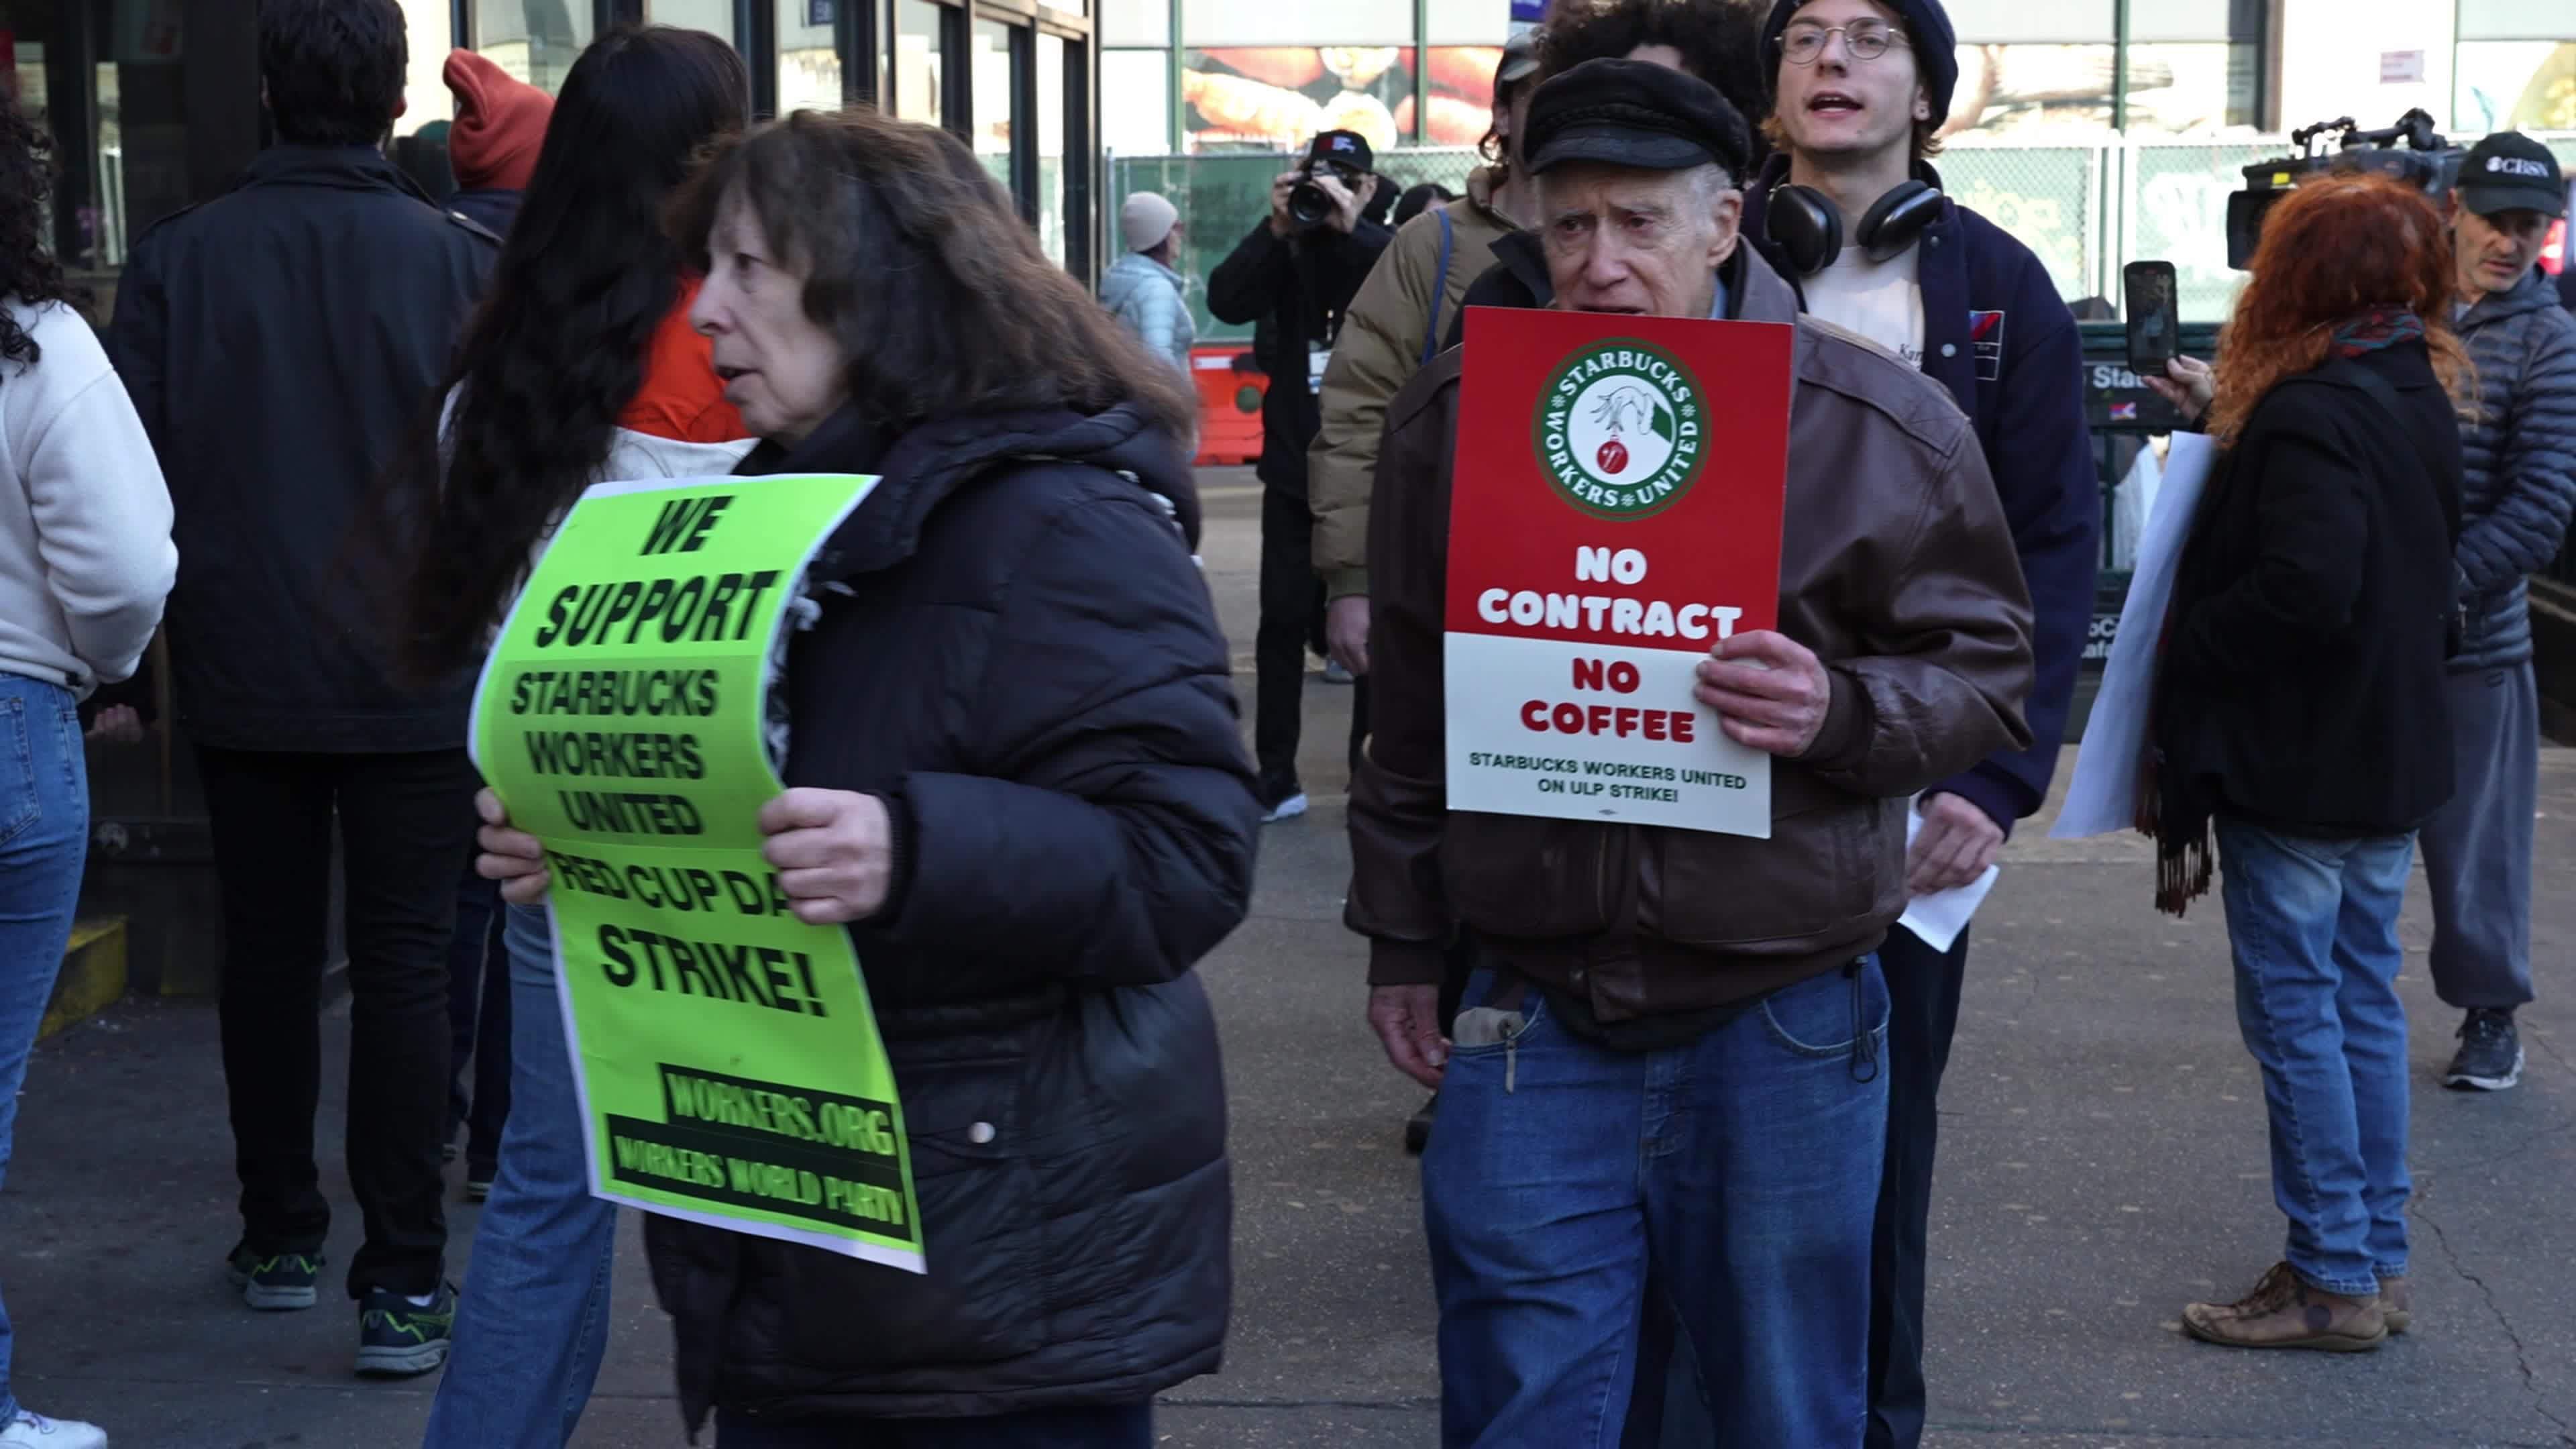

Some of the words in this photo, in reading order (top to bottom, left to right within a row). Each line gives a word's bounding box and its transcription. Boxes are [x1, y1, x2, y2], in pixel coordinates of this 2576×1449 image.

[1560, 350, 1691, 404] STARBUCKS
[2093, 366, 2144, 388] Stat
[1545, 410, 1619, 507] WORKERS
[1635, 421, 1699, 505] UNITED
[639, 495, 737, 556] WE
[1575, 545, 1648, 585] NO
[534, 569, 785, 648] SUPPORT
[1477, 588, 1743, 641] CONTRACT
[510, 669, 719, 717] STARBUCKS
[1572, 657, 1640, 694] NO
[1520, 700, 1695, 743] COFFEE
[524, 731, 706, 780] WORKERS
[1469, 752, 1578, 774] STARBUCKS
[1583, 761, 1676, 782] WORKERS
[1681, 769, 1748, 790] UNITED
[557, 789, 705, 835] UNITED
[1538, 778, 1564, 794] ON
[1570, 780, 1604, 796] ULP
[1610, 784, 1678, 803] STRIKE!
[547, 849, 629, 900] RED
[627, 865, 719, 912] CUP
[720, 869, 792, 917] DA
[598, 923, 829, 1018] STRIKE!
[665, 1072, 897, 1156] WORKERS.ORG
[613, 1135, 727, 1189] WORKERS
[727, 1157, 822, 1205] WORLD
